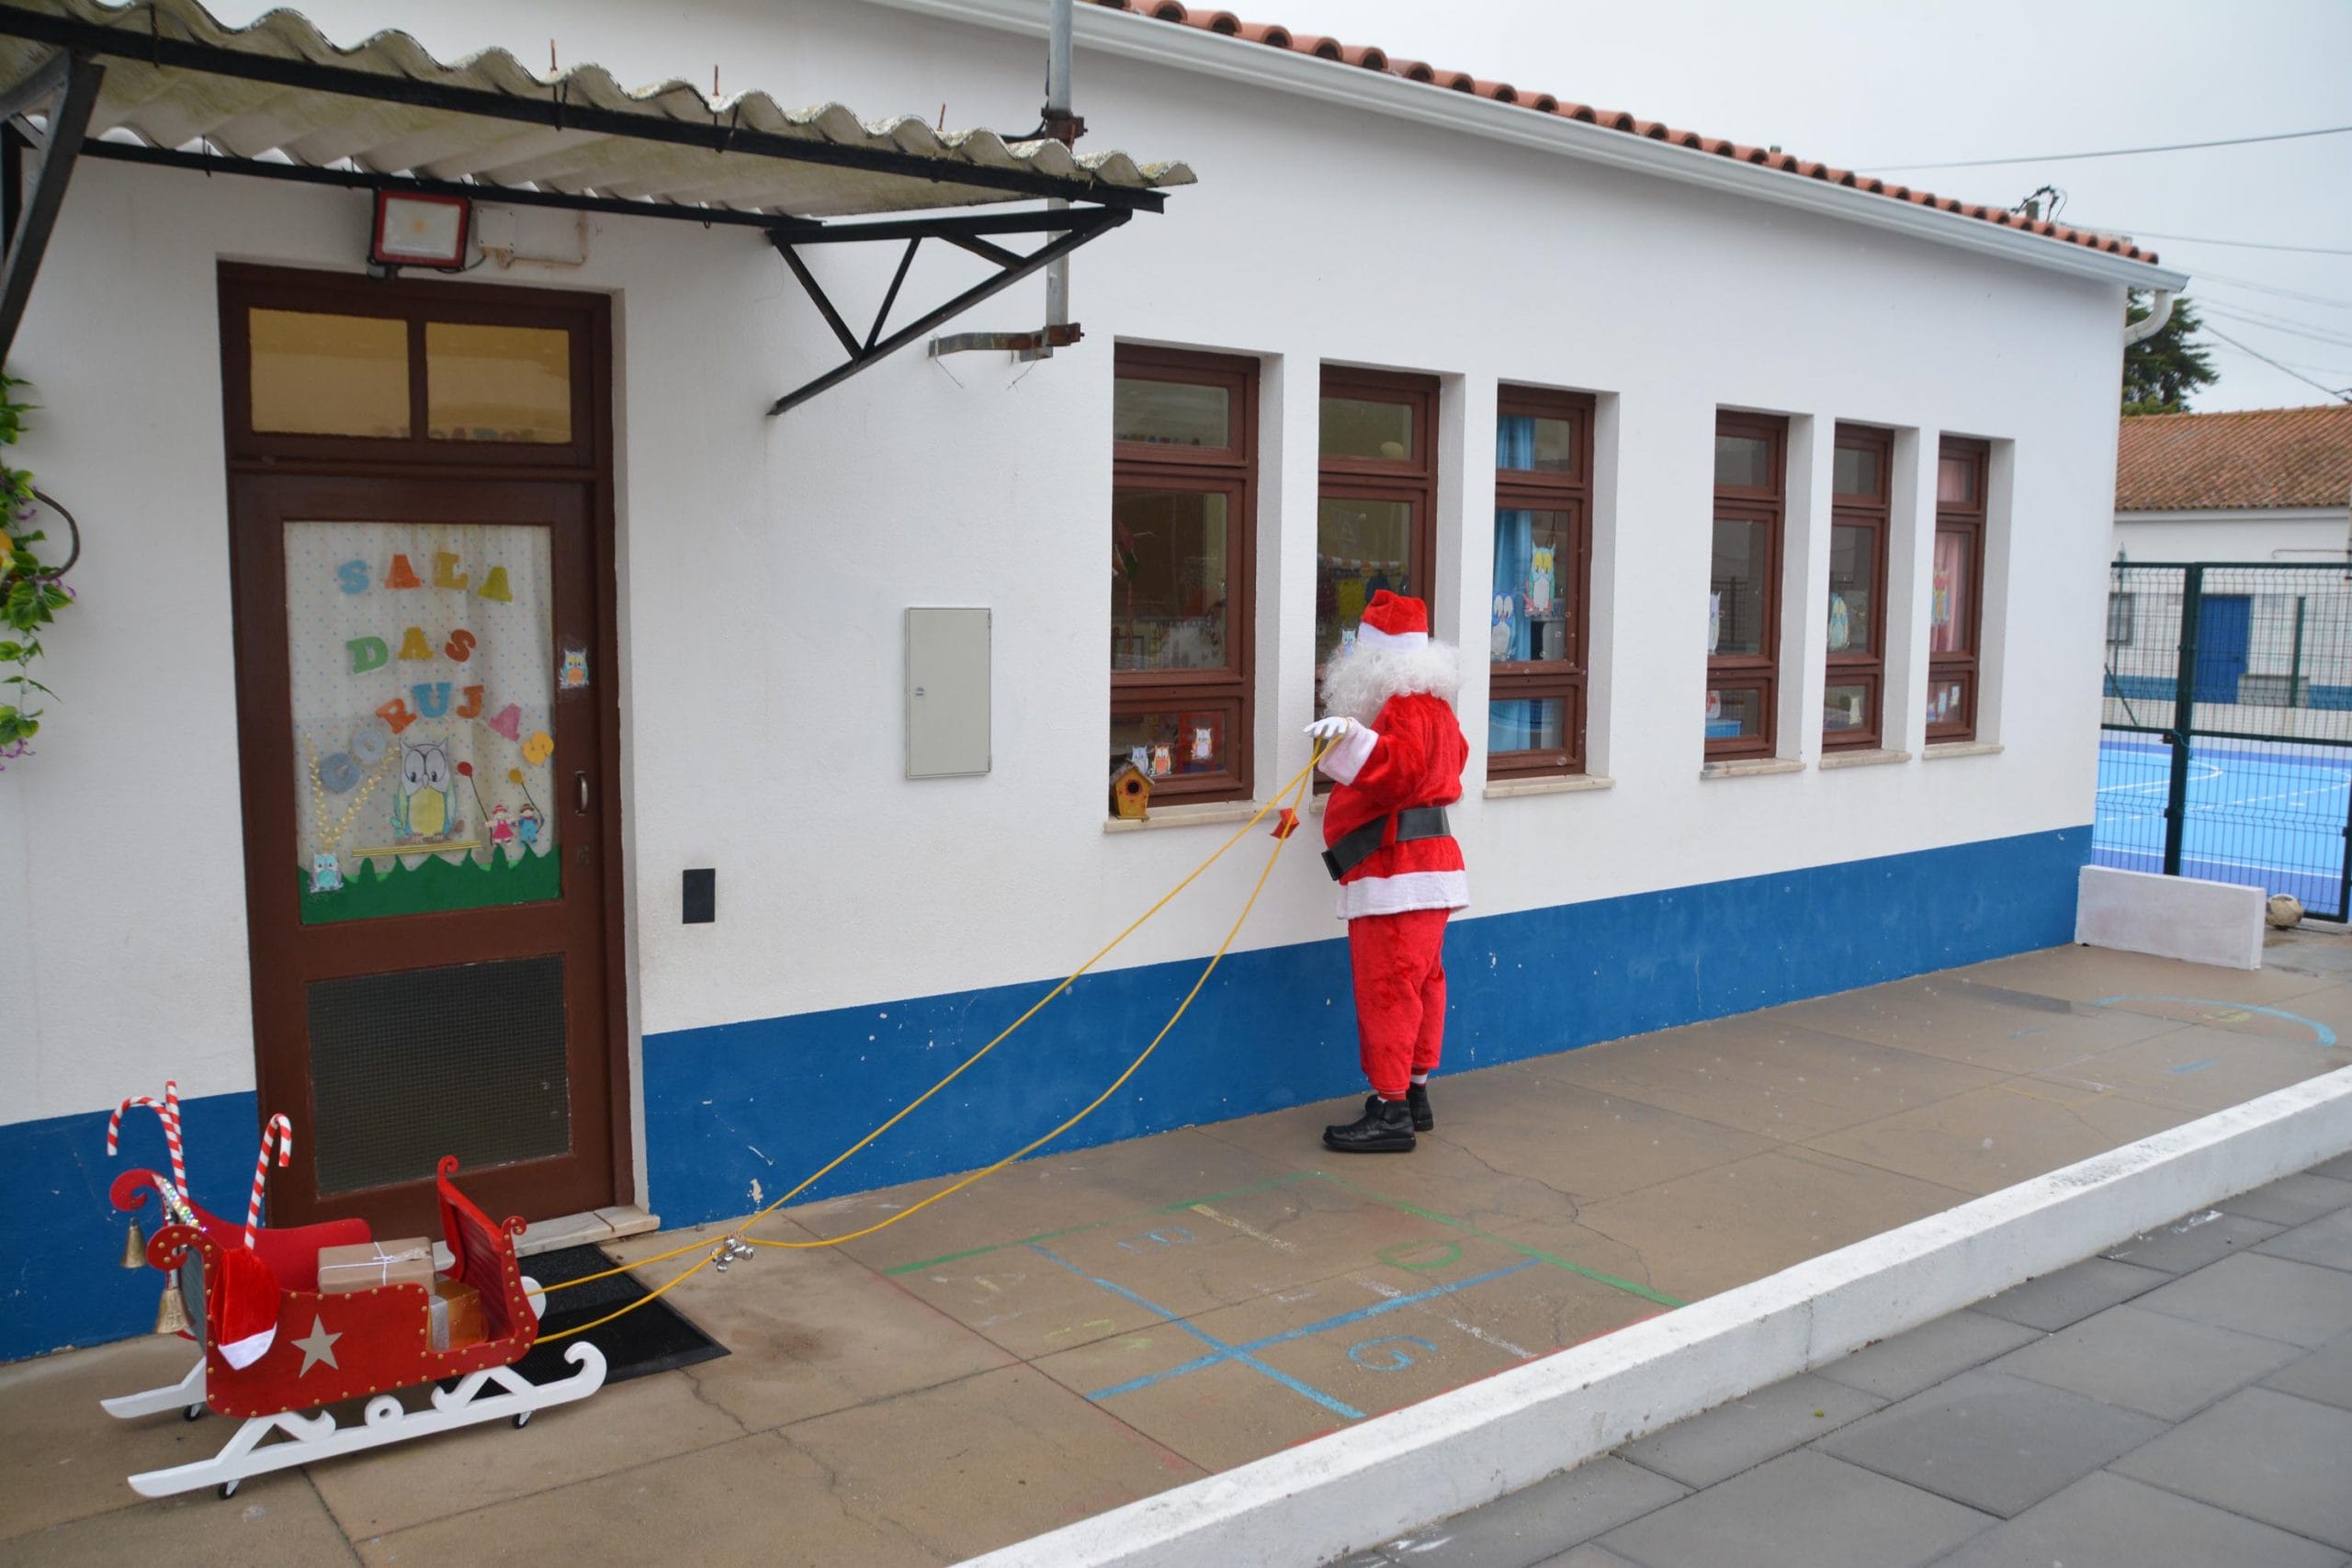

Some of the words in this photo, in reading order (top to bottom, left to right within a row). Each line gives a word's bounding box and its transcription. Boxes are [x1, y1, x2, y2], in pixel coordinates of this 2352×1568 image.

[337, 551, 513, 603] SALA
[345, 626, 476, 674] DAS
[319, 682, 555, 795] CORUJAS
[1347, 1335, 1439, 1371] G
